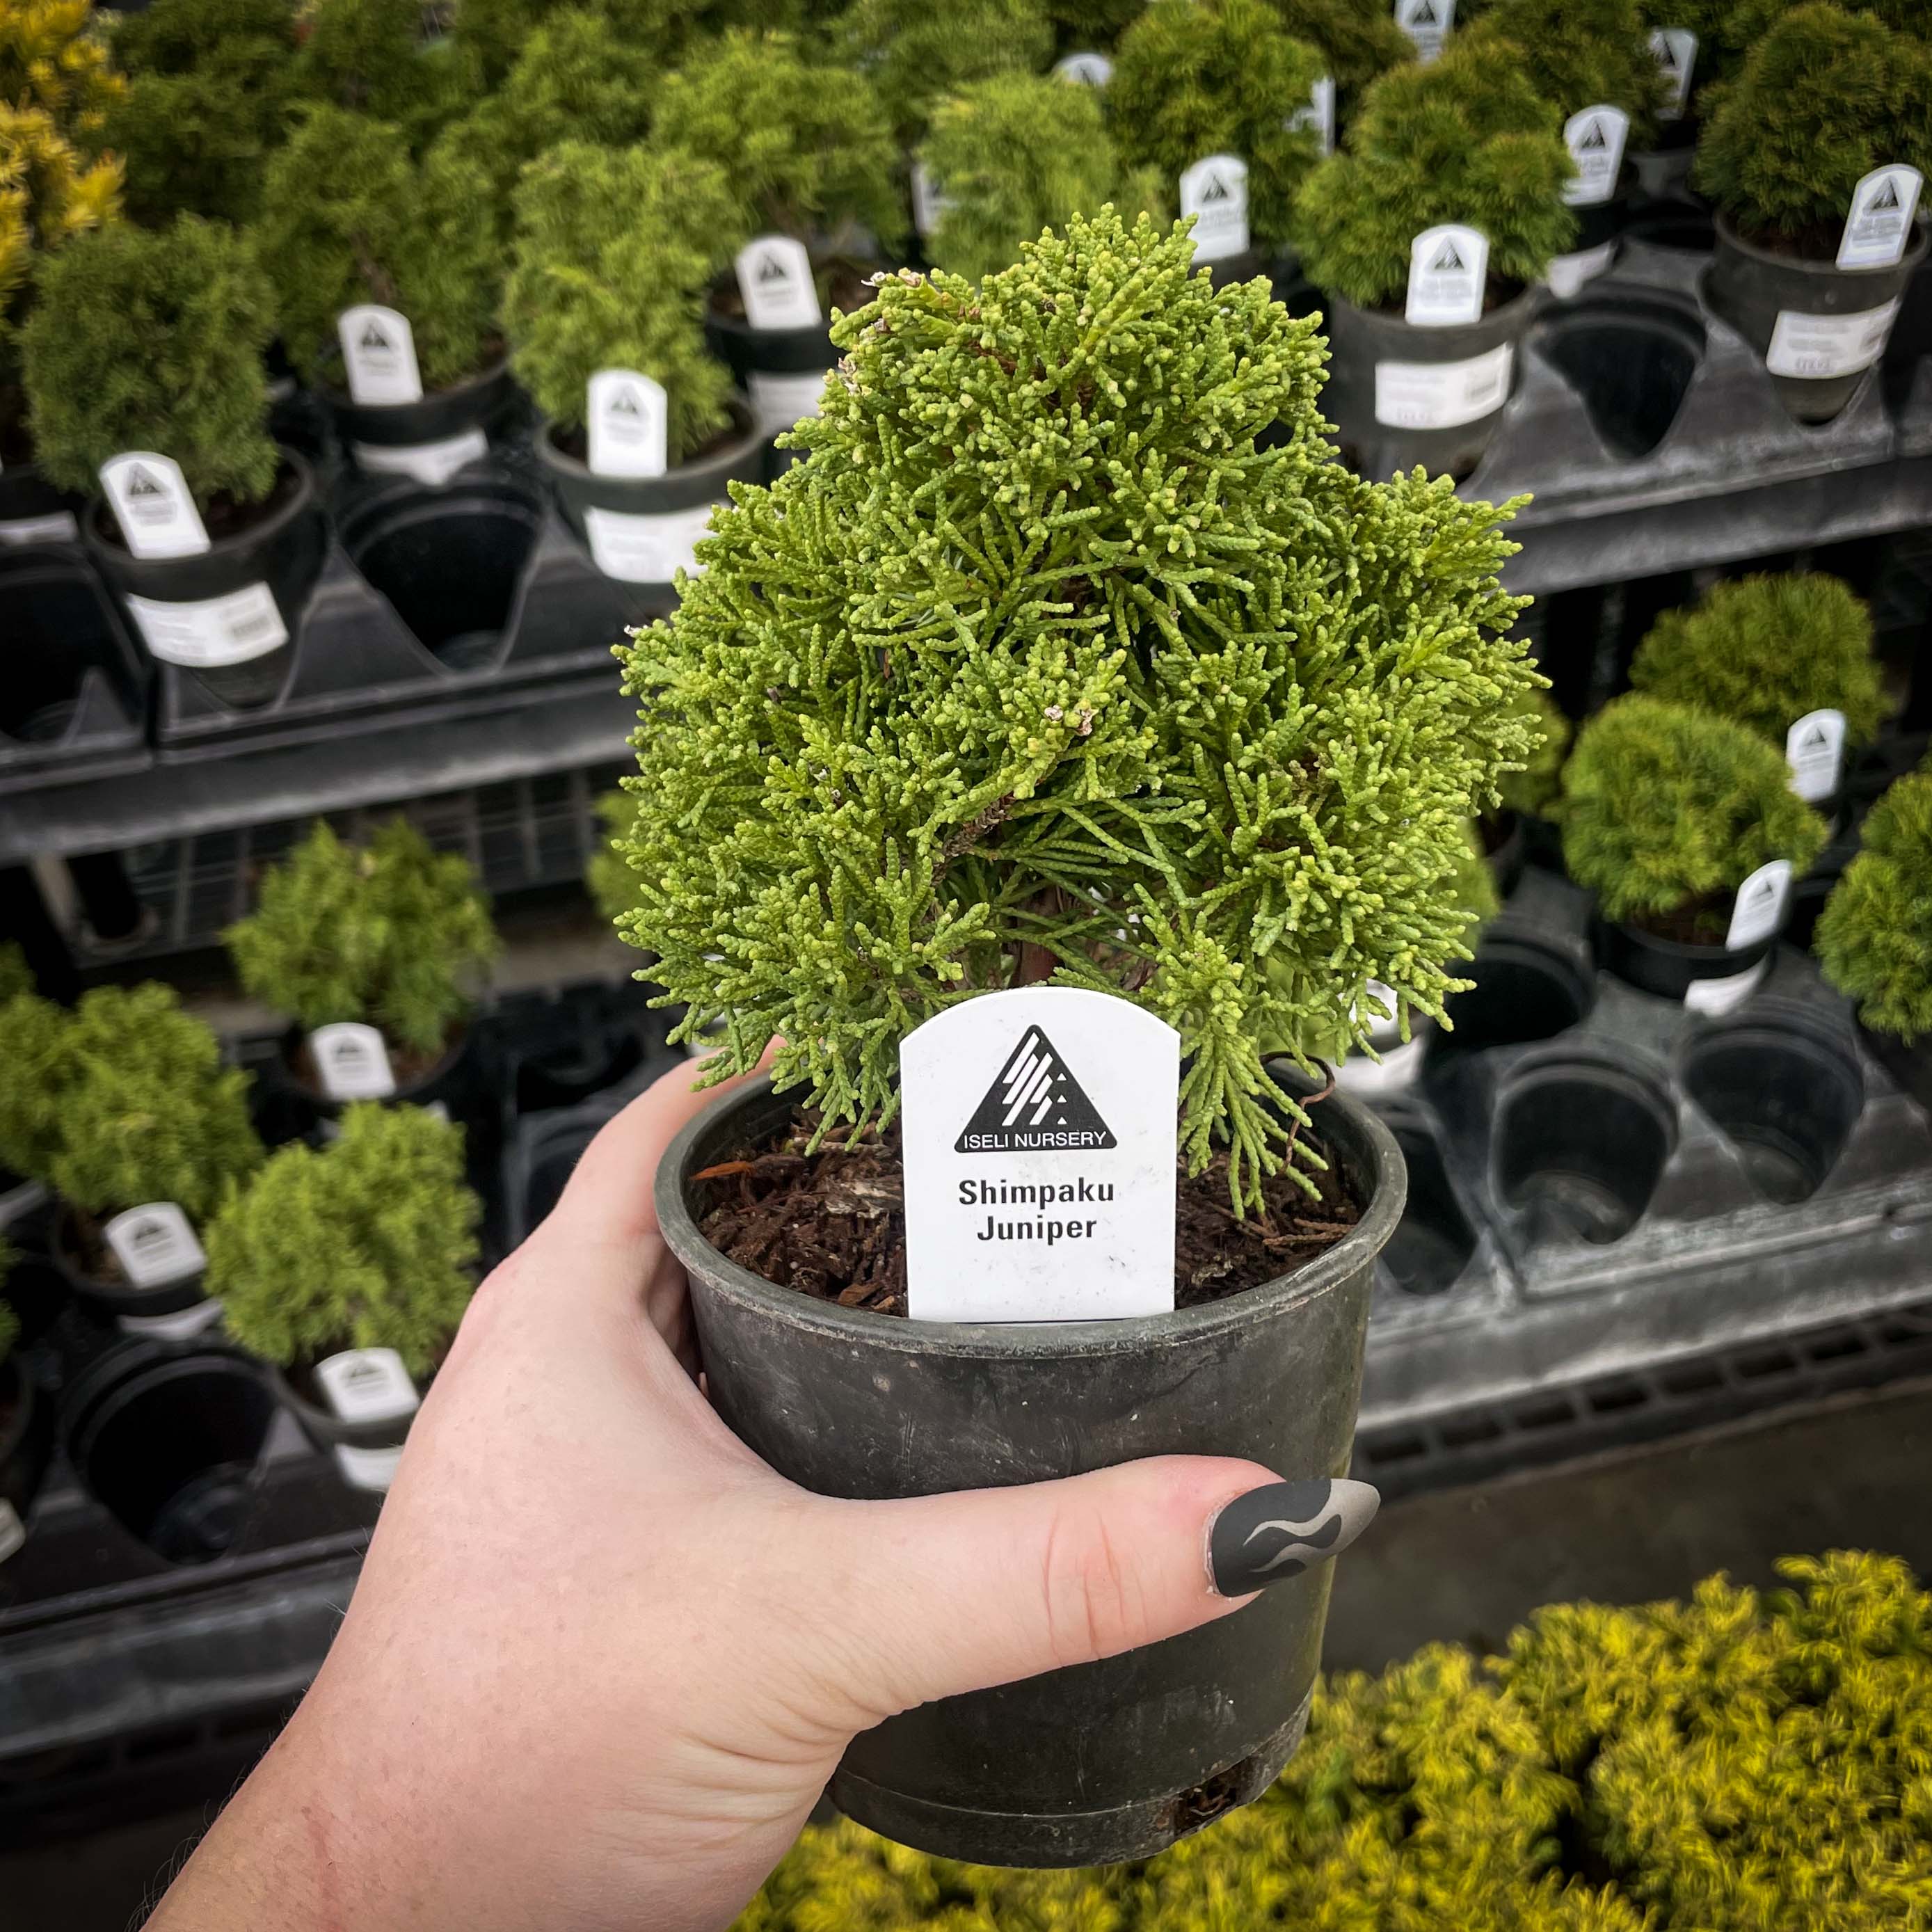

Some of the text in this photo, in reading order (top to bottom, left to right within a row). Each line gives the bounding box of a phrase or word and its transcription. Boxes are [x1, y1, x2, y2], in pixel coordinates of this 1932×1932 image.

[964, 1131, 1107, 1149] ISELI NURSERY
[959, 1177, 1114, 1209] Shimpaku
[977, 1215, 1096, 1245] Juniper
